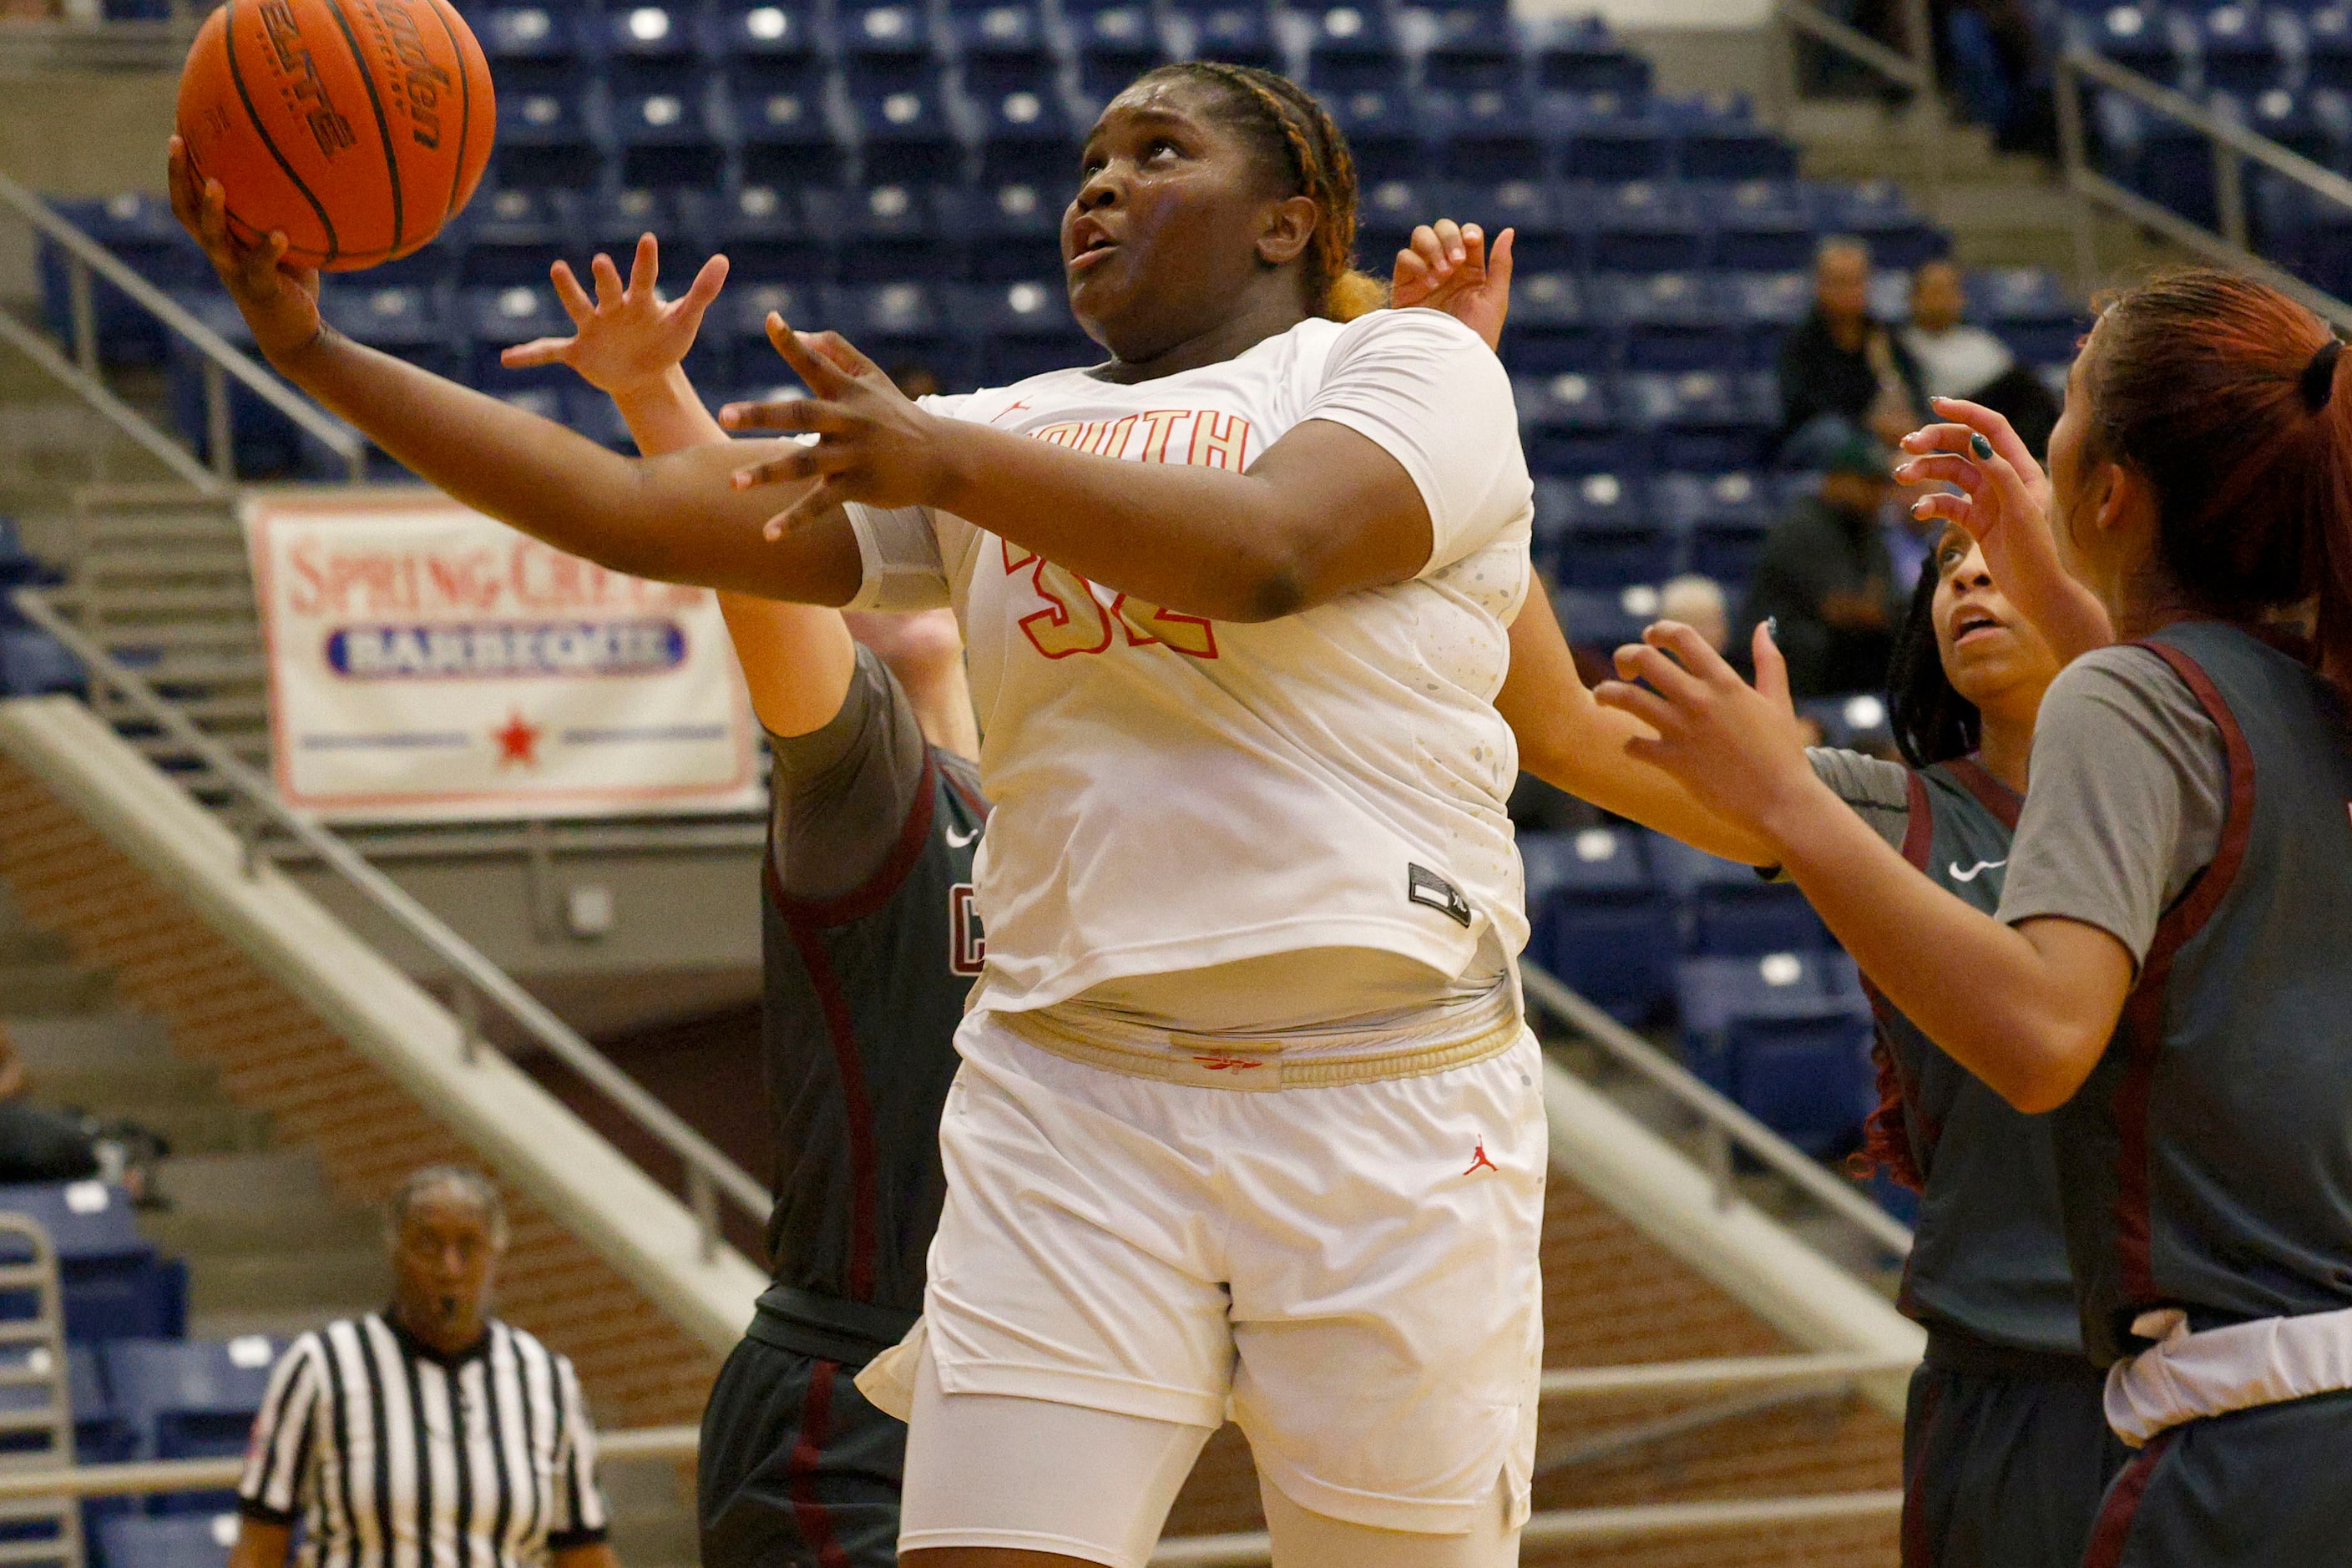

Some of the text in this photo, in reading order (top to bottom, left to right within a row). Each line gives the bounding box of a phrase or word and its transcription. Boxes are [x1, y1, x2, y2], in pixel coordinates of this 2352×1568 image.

[376, 0, 451, 151] aden
[1029, 409, 1250, 474] UTH
[291, 534, 503, 615] SPRING
